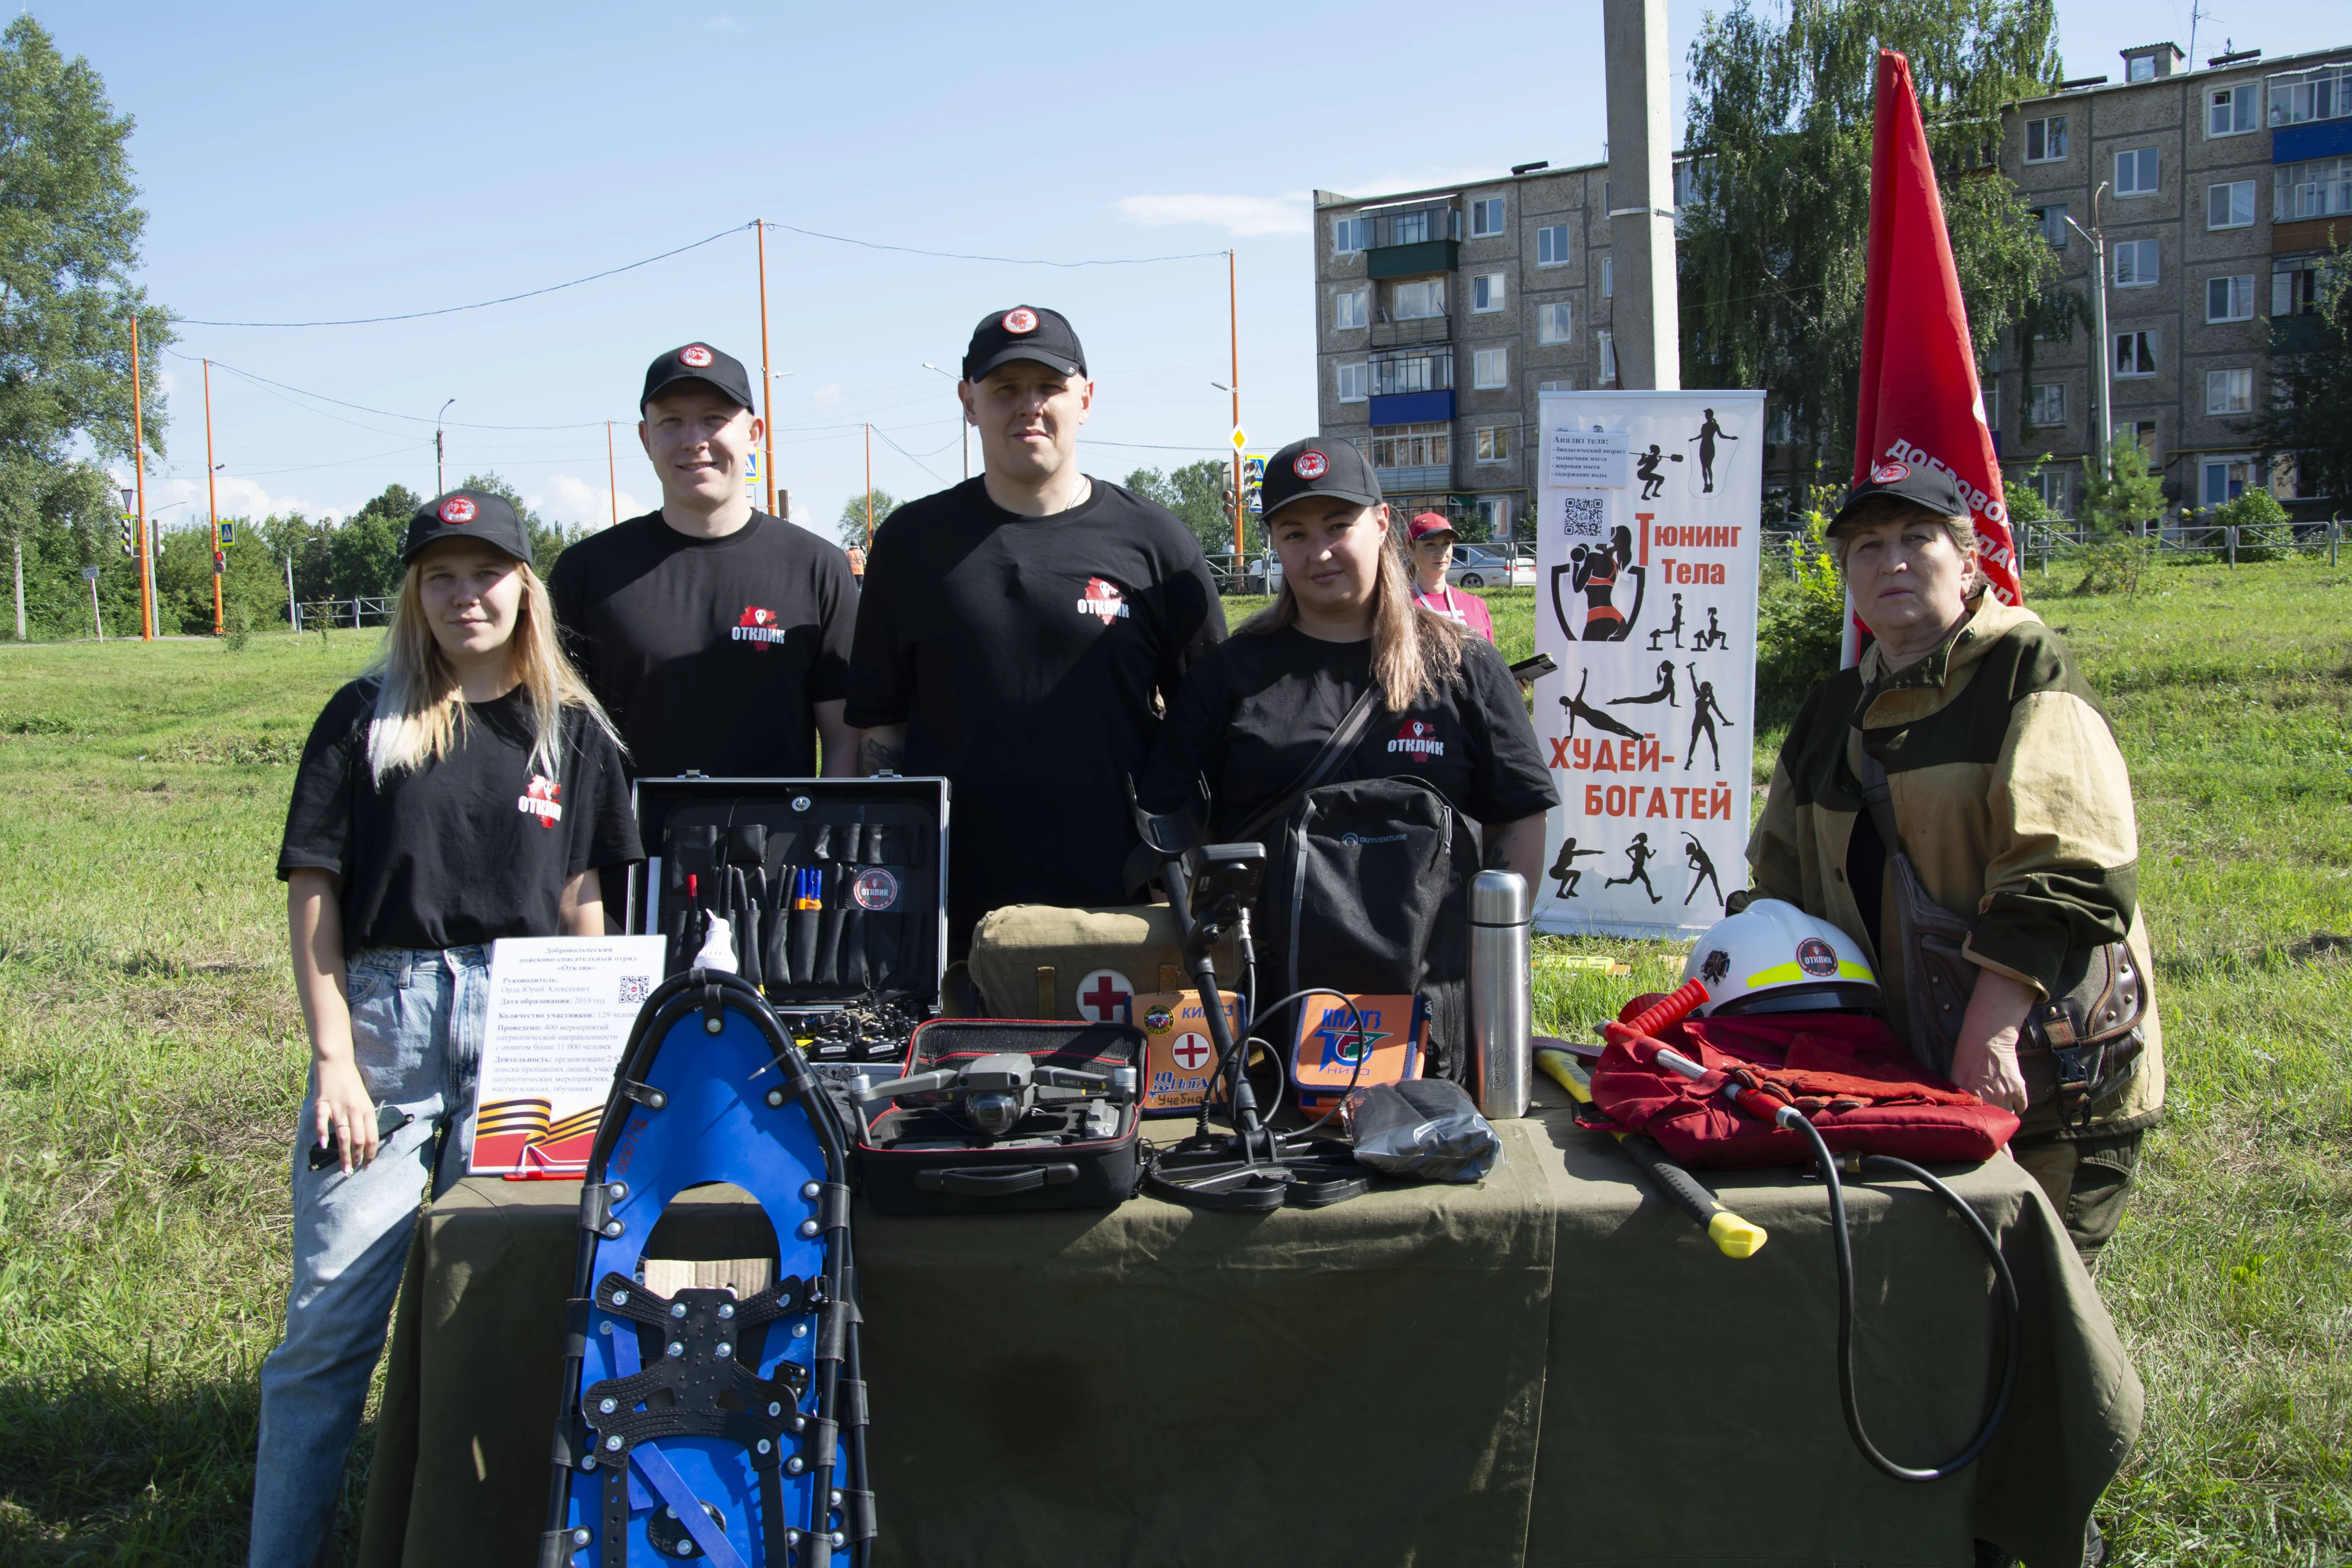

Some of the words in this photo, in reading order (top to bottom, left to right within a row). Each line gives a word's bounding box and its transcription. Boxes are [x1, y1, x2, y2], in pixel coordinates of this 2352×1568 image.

[1635, 513, 1742, 566] Тюнинг
[86, 568, 97, 578] СТОП
[1662, 559, 1725, 584] Тела
[1077, 599, 1129, 618] ОТКЛИК
[732, 626, 785, 644] ОТКЛИК
[1388, 739, 1444, 756] ОТКЛИК
[1549, 733, 1675, 774] ХУДЕЙ-
[1585, 781, 1732, 821] БОГАТЕЙ
[1360, 834, 1407, 843] OUTVENTURE
[519, 955, 612, 964] поисково-спасательный
[1804, 956, 1833, 964] ОТКЛИК
[560, 1024, 609, 1032] мероприятий
